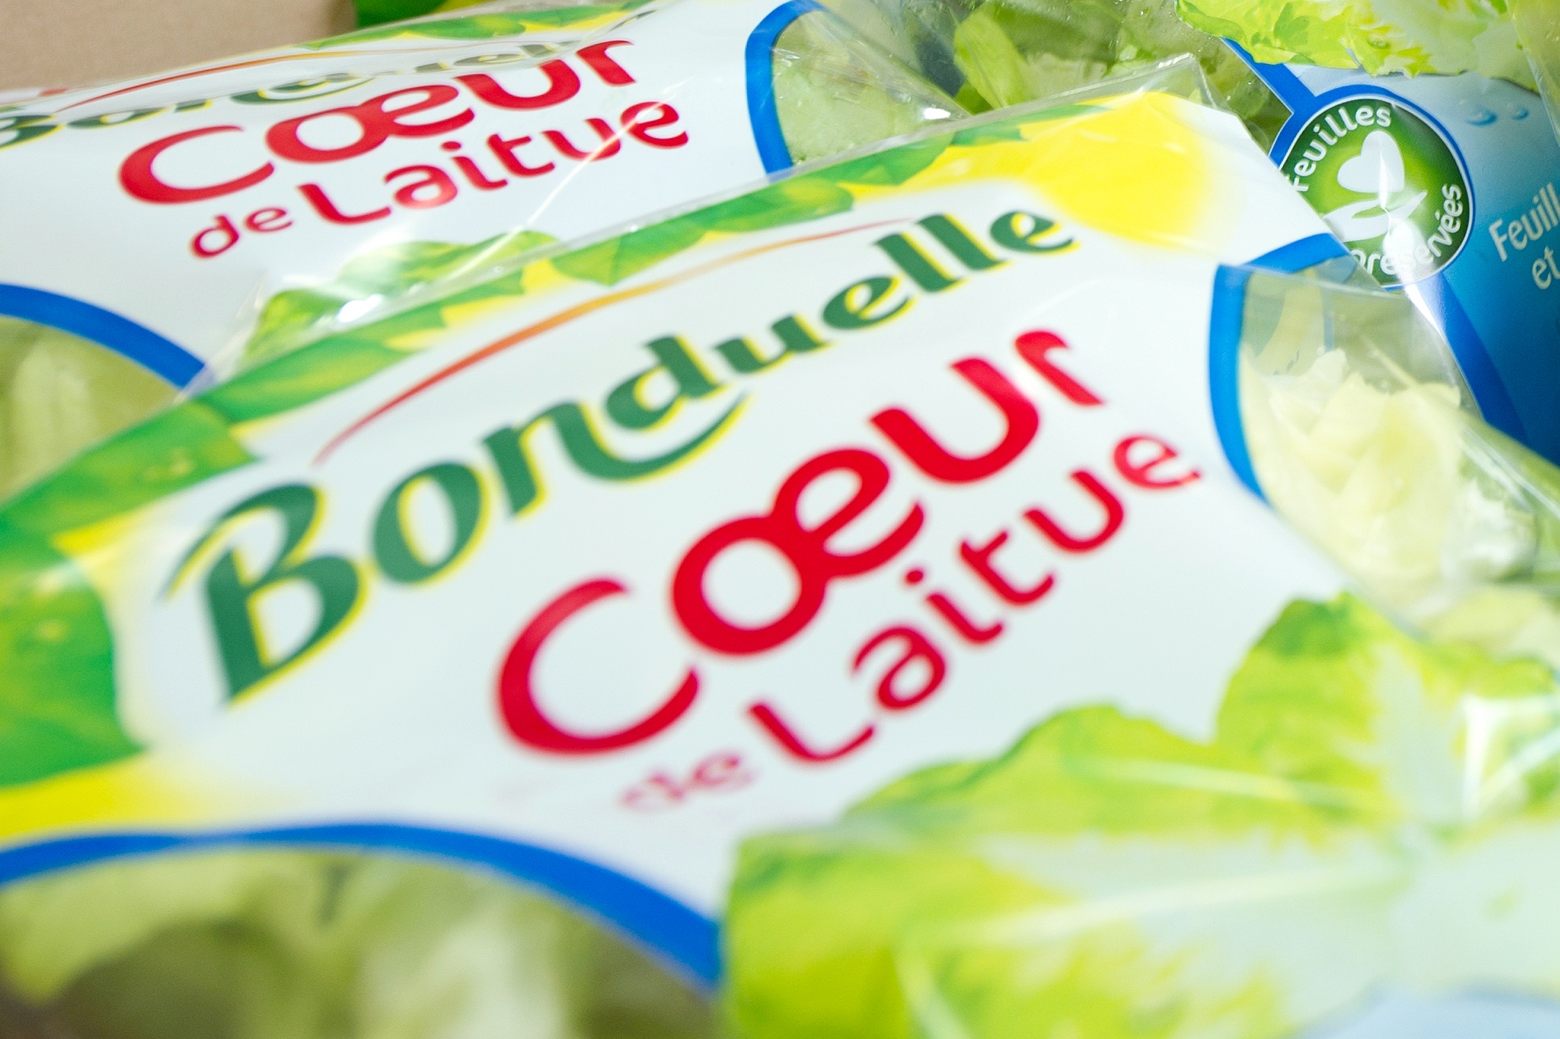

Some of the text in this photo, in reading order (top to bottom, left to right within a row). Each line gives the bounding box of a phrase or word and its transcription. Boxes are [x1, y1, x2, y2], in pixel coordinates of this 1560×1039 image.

[117, 38, 636, 205] Cœur
[190, 100, 690, 259] de Laitue
[152, 205, 1082, 710] Bonduelle
[493, 327, 1109, 760] Cœur
[744, 430, 1203, 765] Laitue
